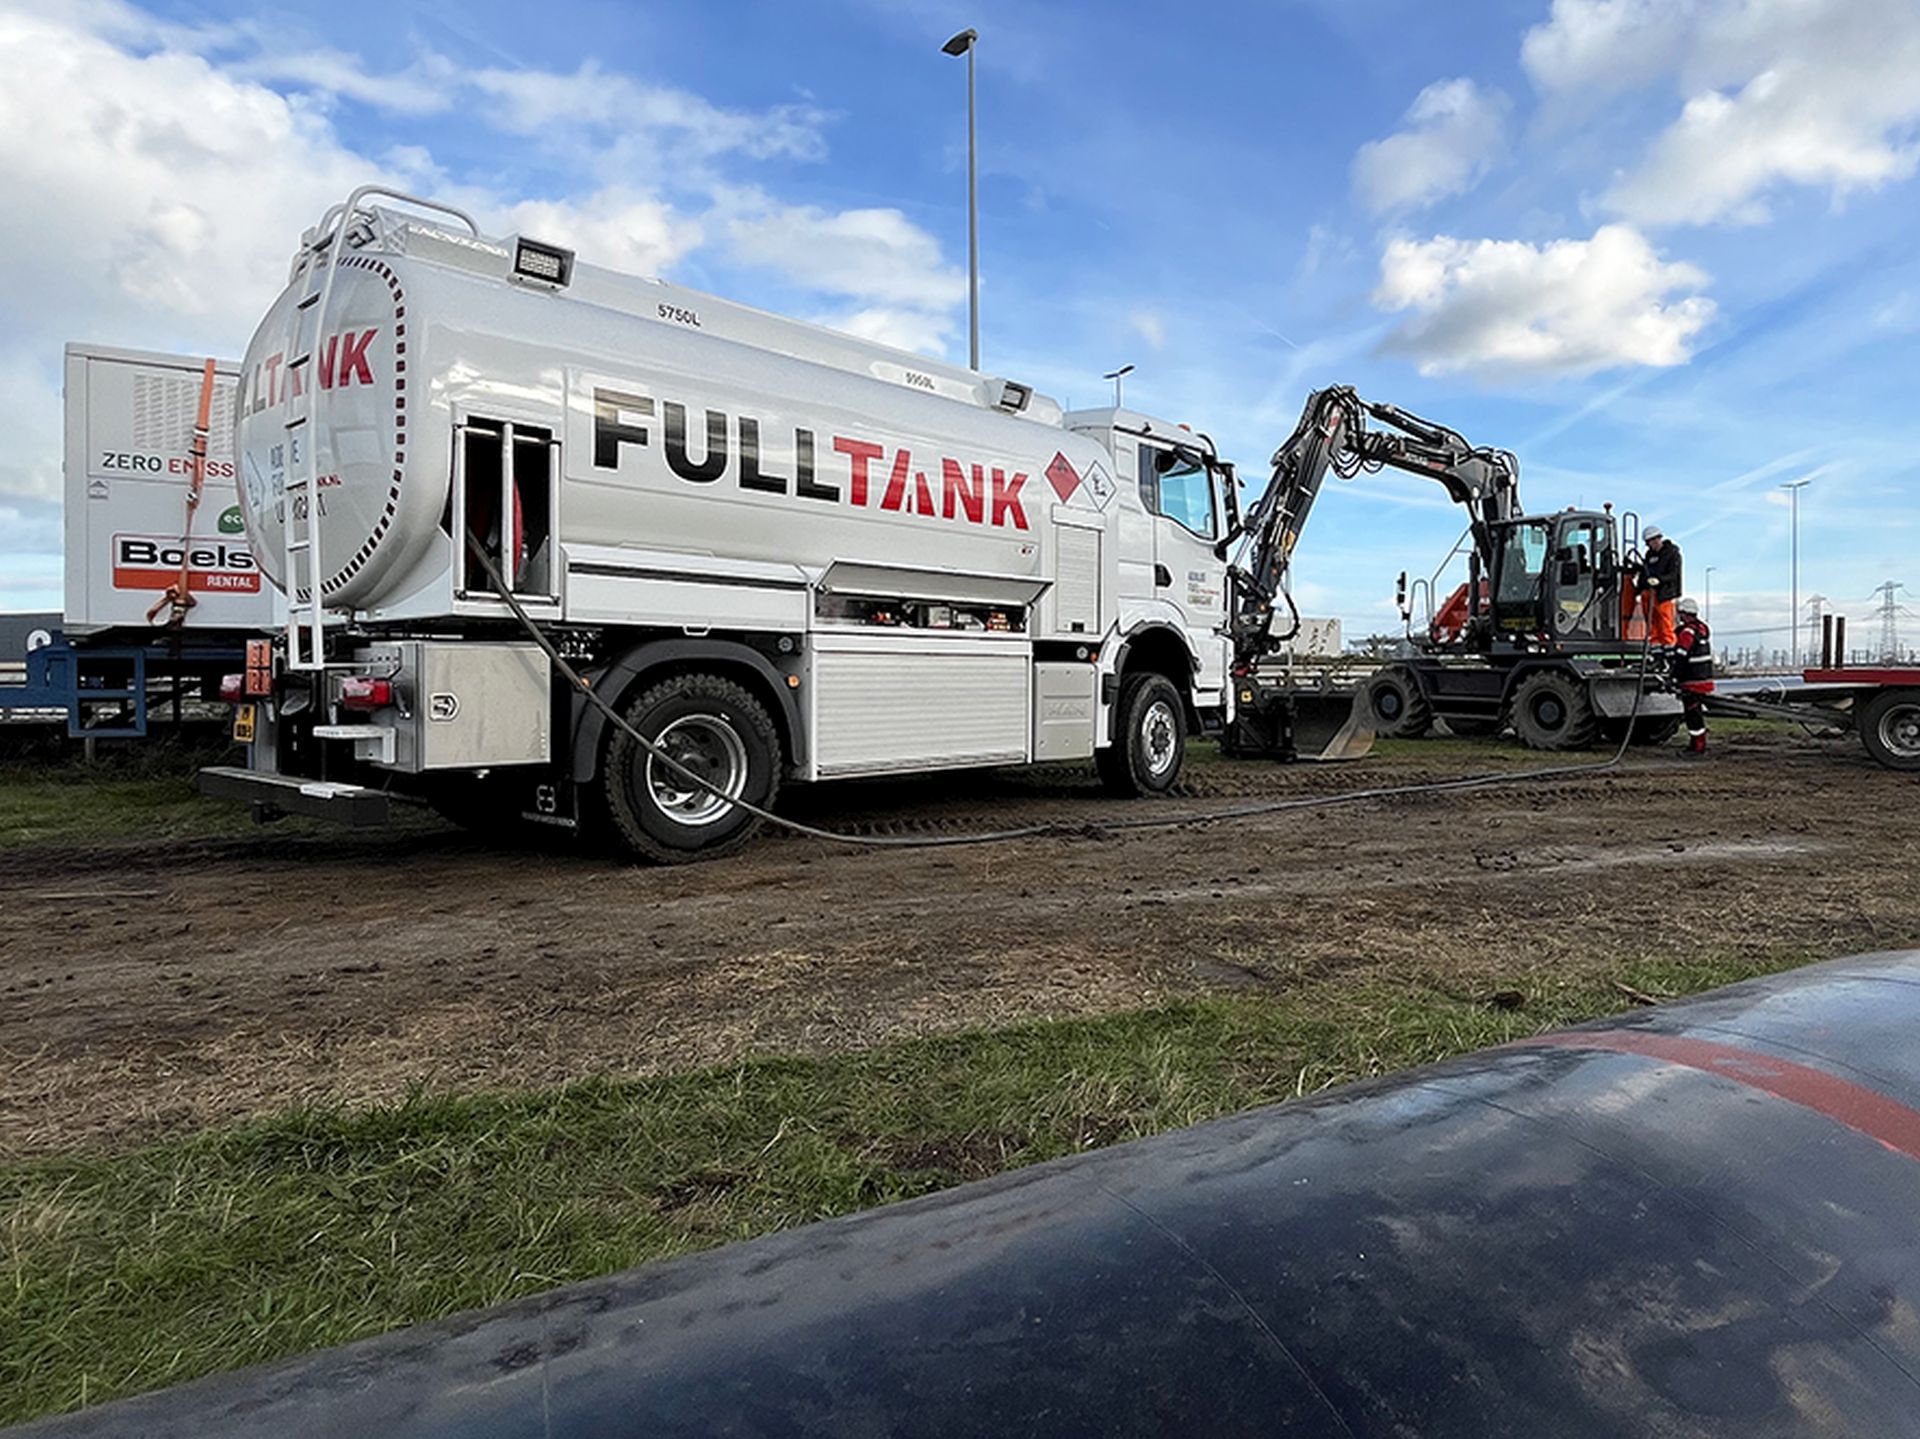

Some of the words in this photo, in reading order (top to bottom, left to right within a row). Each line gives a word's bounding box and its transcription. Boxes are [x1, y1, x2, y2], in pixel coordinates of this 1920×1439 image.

[658, 303, 701, 327] 5750L
[102, 452, 163, 472] ZERO
[593, 386, 1029, 530] FULLTANK
[120, 540, 254, 568] Boels
[206, 575, 253, 588] RENTAL
